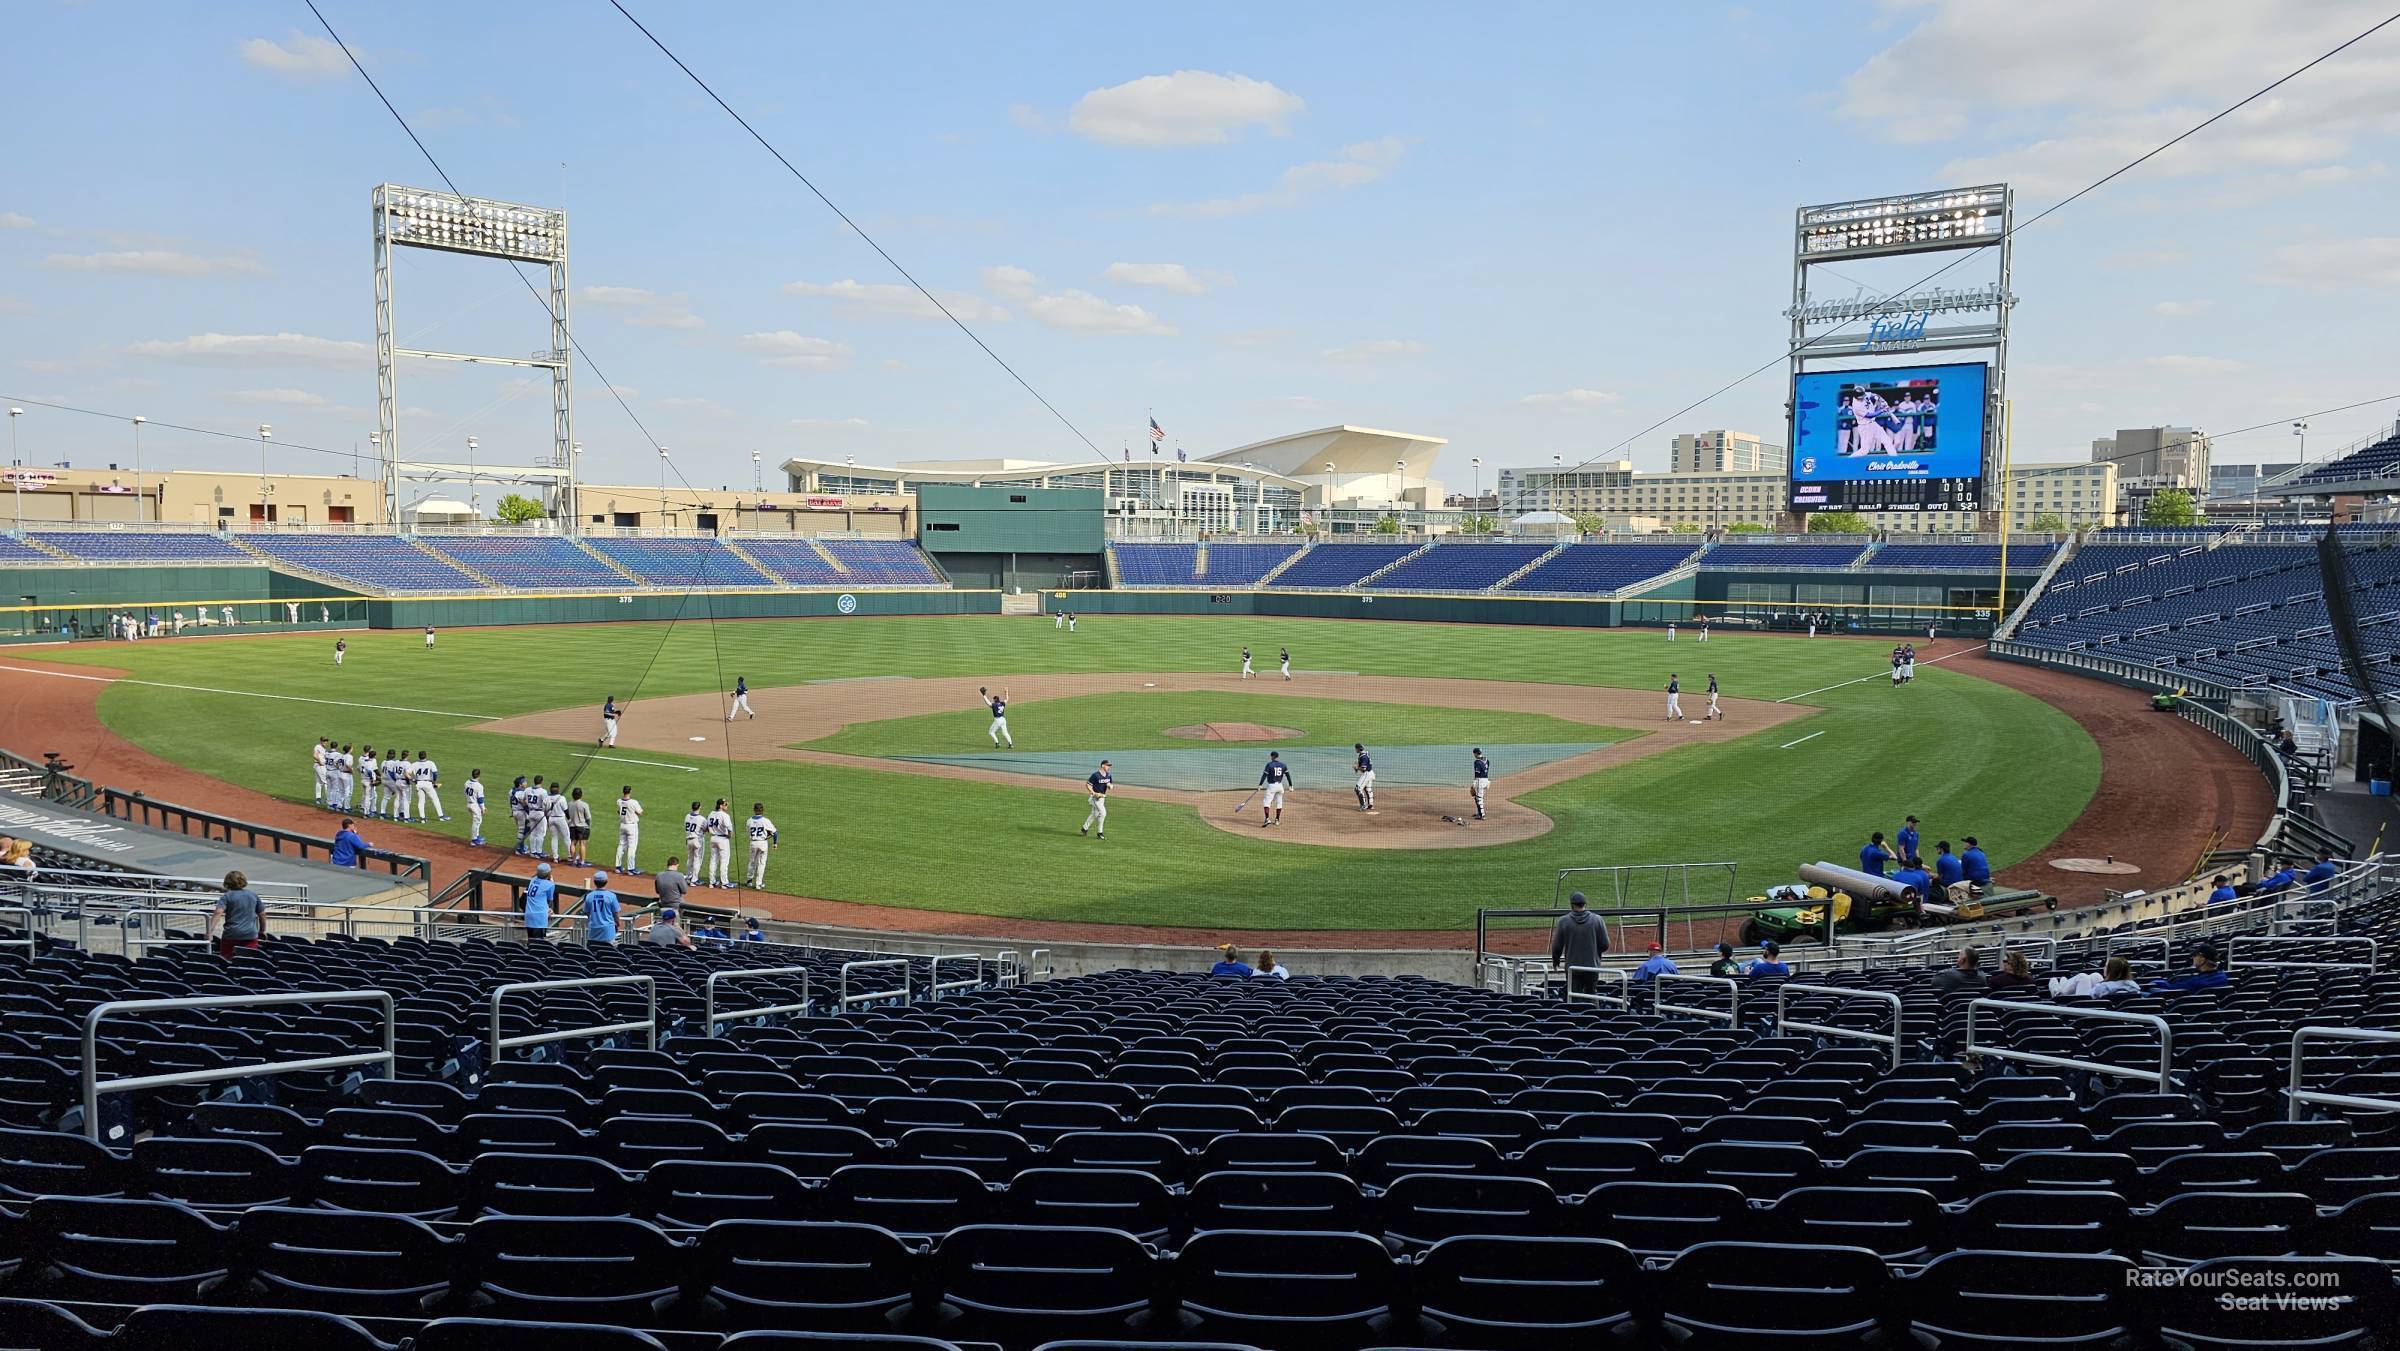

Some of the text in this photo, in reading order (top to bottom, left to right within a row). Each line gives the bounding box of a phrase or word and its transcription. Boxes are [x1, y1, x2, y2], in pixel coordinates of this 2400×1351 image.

[1860, 311, 1929, 351] field
[1871, 340, 1919, 352] OMAHA
[1975, 609, 1991, 618] 335
[416, 767, 429, 776] 44
[1274, 767, 1283, 777] 16
[685, 822, 697, 833] 20
[708, 817, 719, 828] 34
[750, 826, 764, 837] 22
[592, 899, 604, 913] 17
